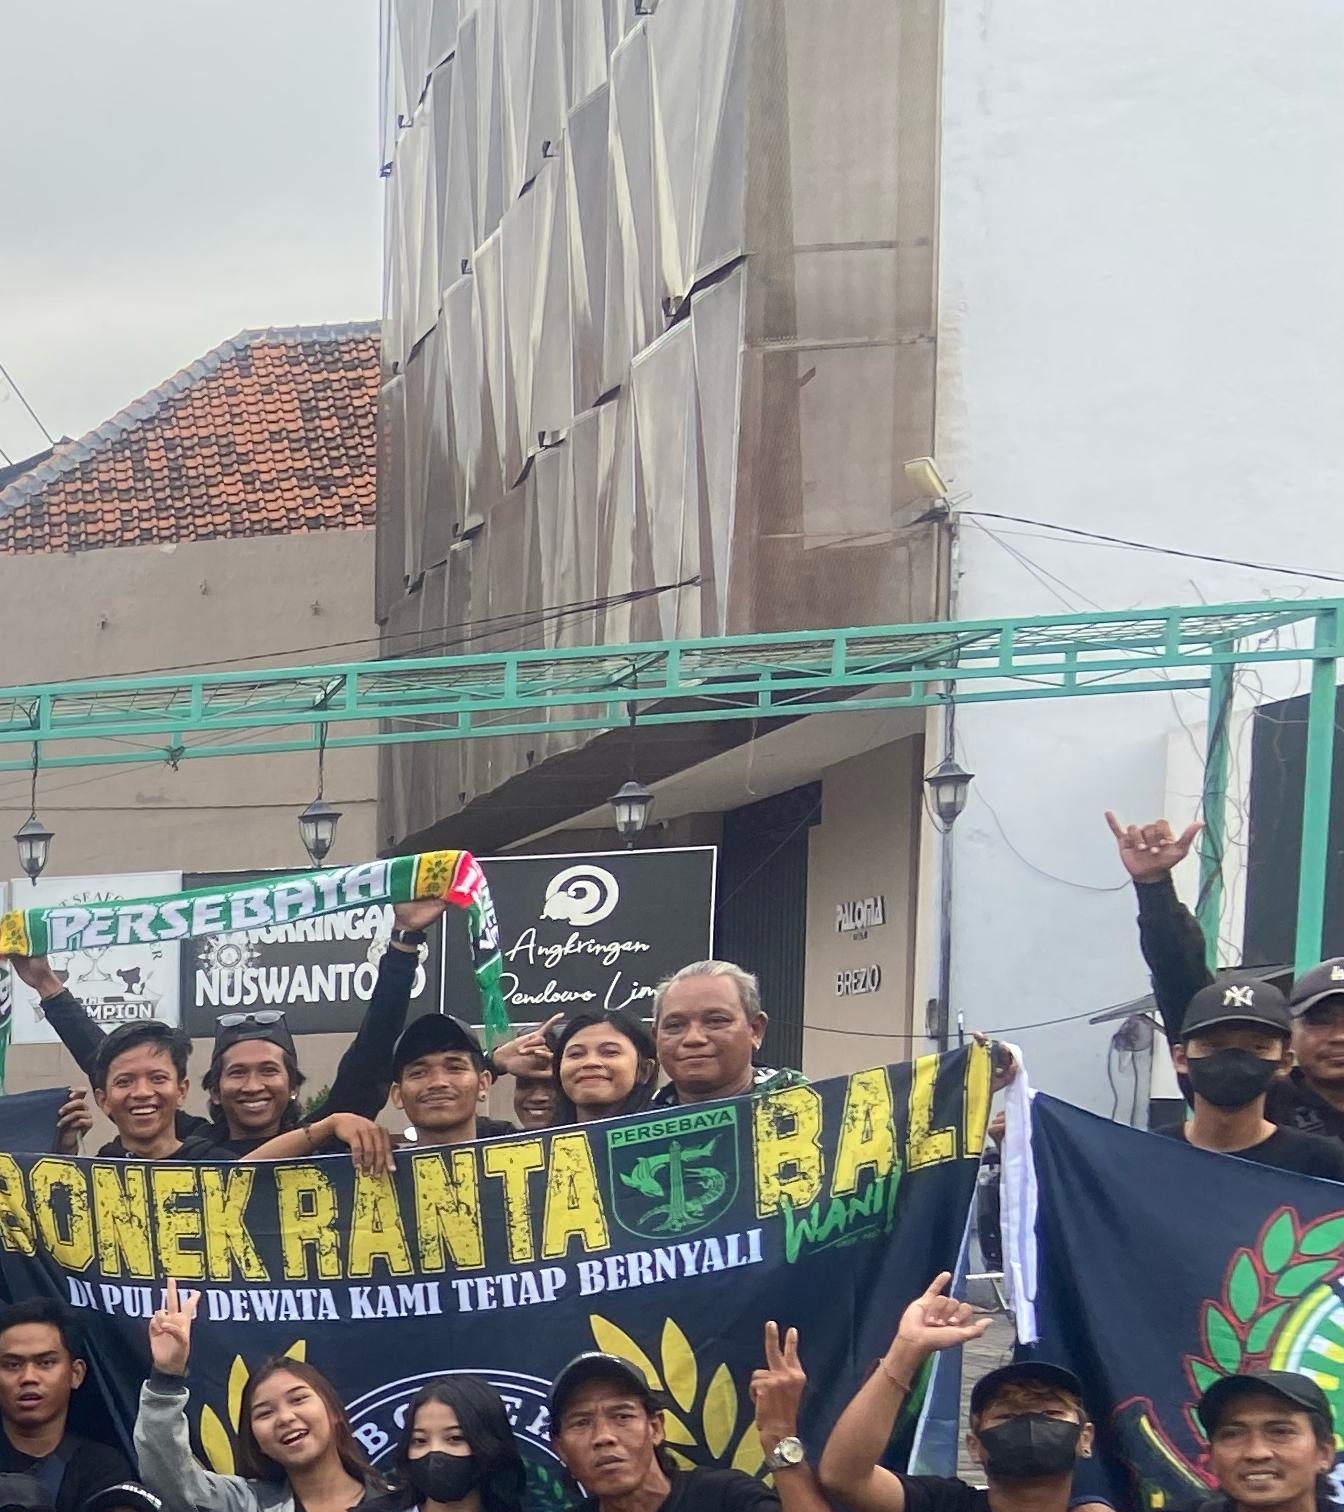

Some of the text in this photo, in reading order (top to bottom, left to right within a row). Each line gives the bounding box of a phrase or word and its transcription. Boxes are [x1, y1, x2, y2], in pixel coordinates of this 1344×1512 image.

[46, 860, 392, 952] PERSEBAYA
[505, 927, 651, 968] Angkringan
[195, 961, 427, 1007] NUSWANTOO
[603, 971, 658, 1011] Lim
[86, 1002, 153, 1020] MPION
[610, 1108, 734, 1147] PERSEBAYA
[273, 1130, 611, 1282] RANTA
[751, 1040, 992, 1220] BALI
[66, 1275, 98, 1310] DI
[207, 1286, 341, 1322] DEWATA
[348, 1280, 443, 1321] KAMI
[451, 1266, 567, 1310] TETAP
[578, 1228, 764, 1297] BERNYALI
